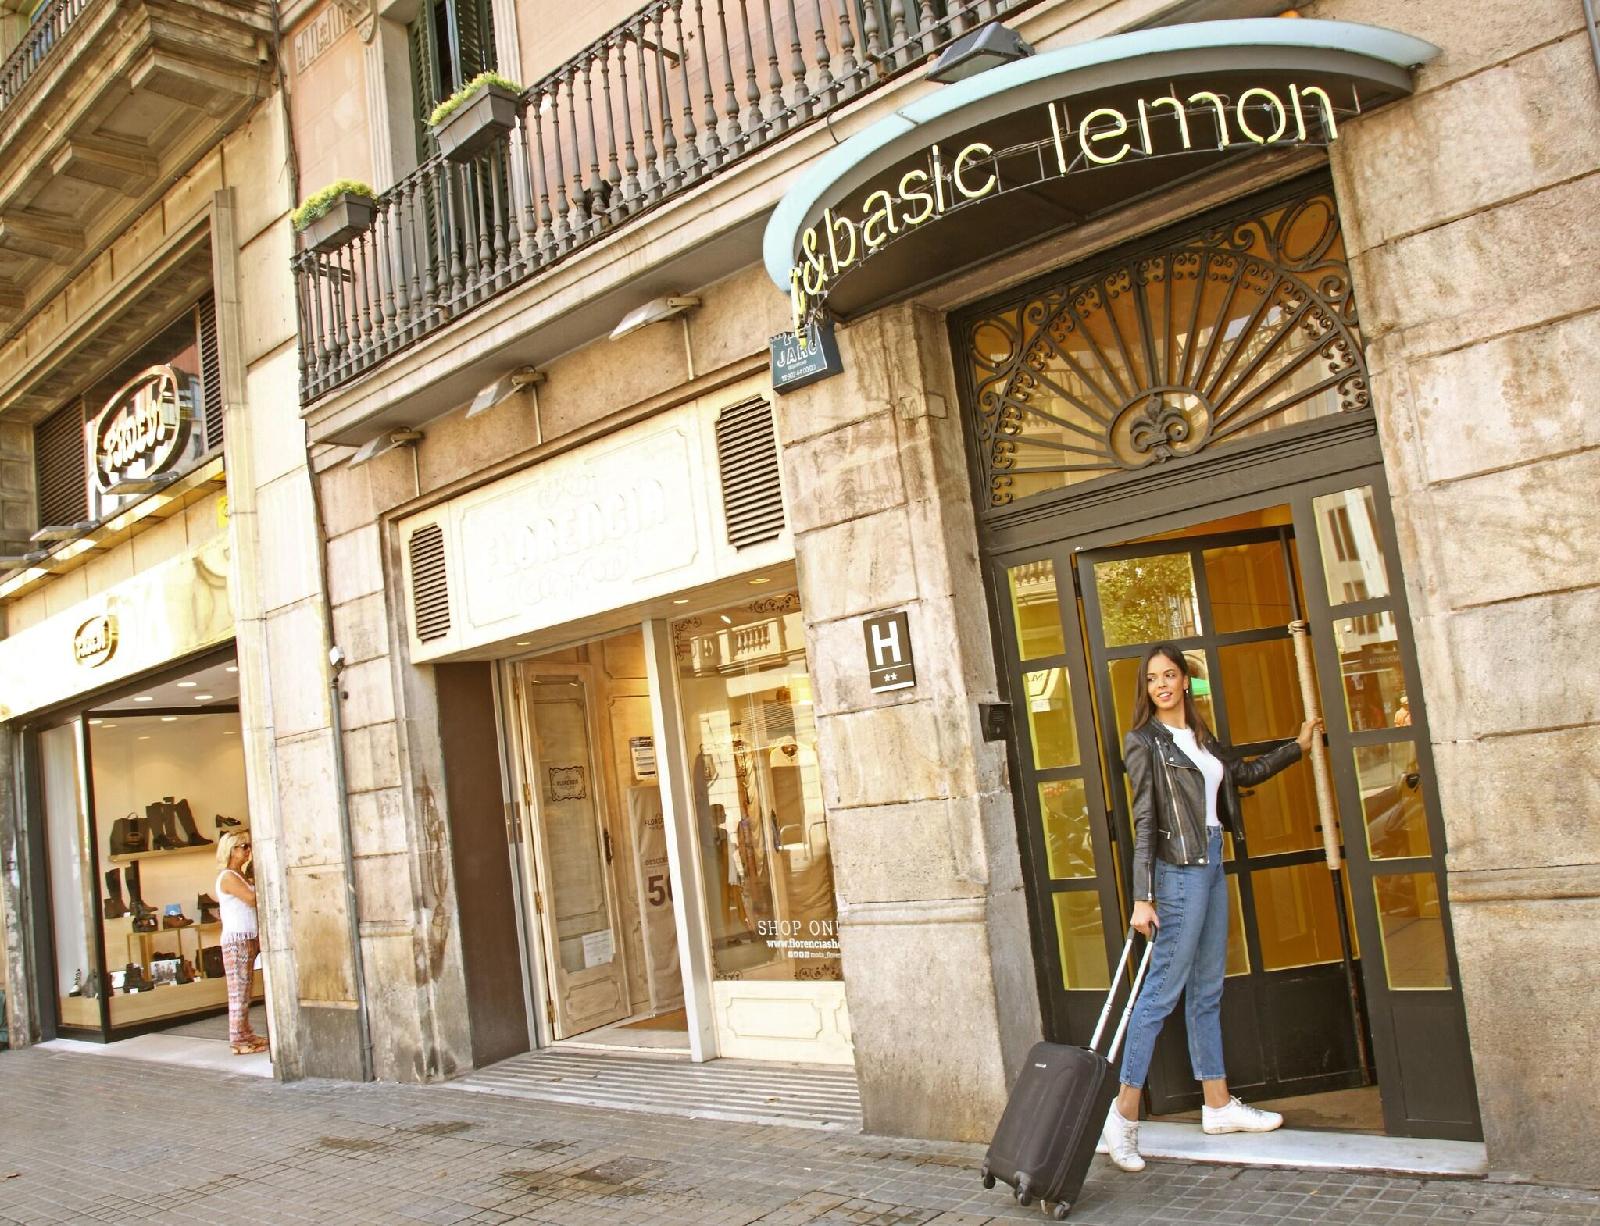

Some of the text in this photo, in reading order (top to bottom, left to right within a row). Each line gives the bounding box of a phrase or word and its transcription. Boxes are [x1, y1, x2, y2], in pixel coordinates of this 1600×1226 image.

[1046, 82, 1339, 176] lemon
[871, 620, 902, 666] H
[757, 920, 802, 936] SHOP
